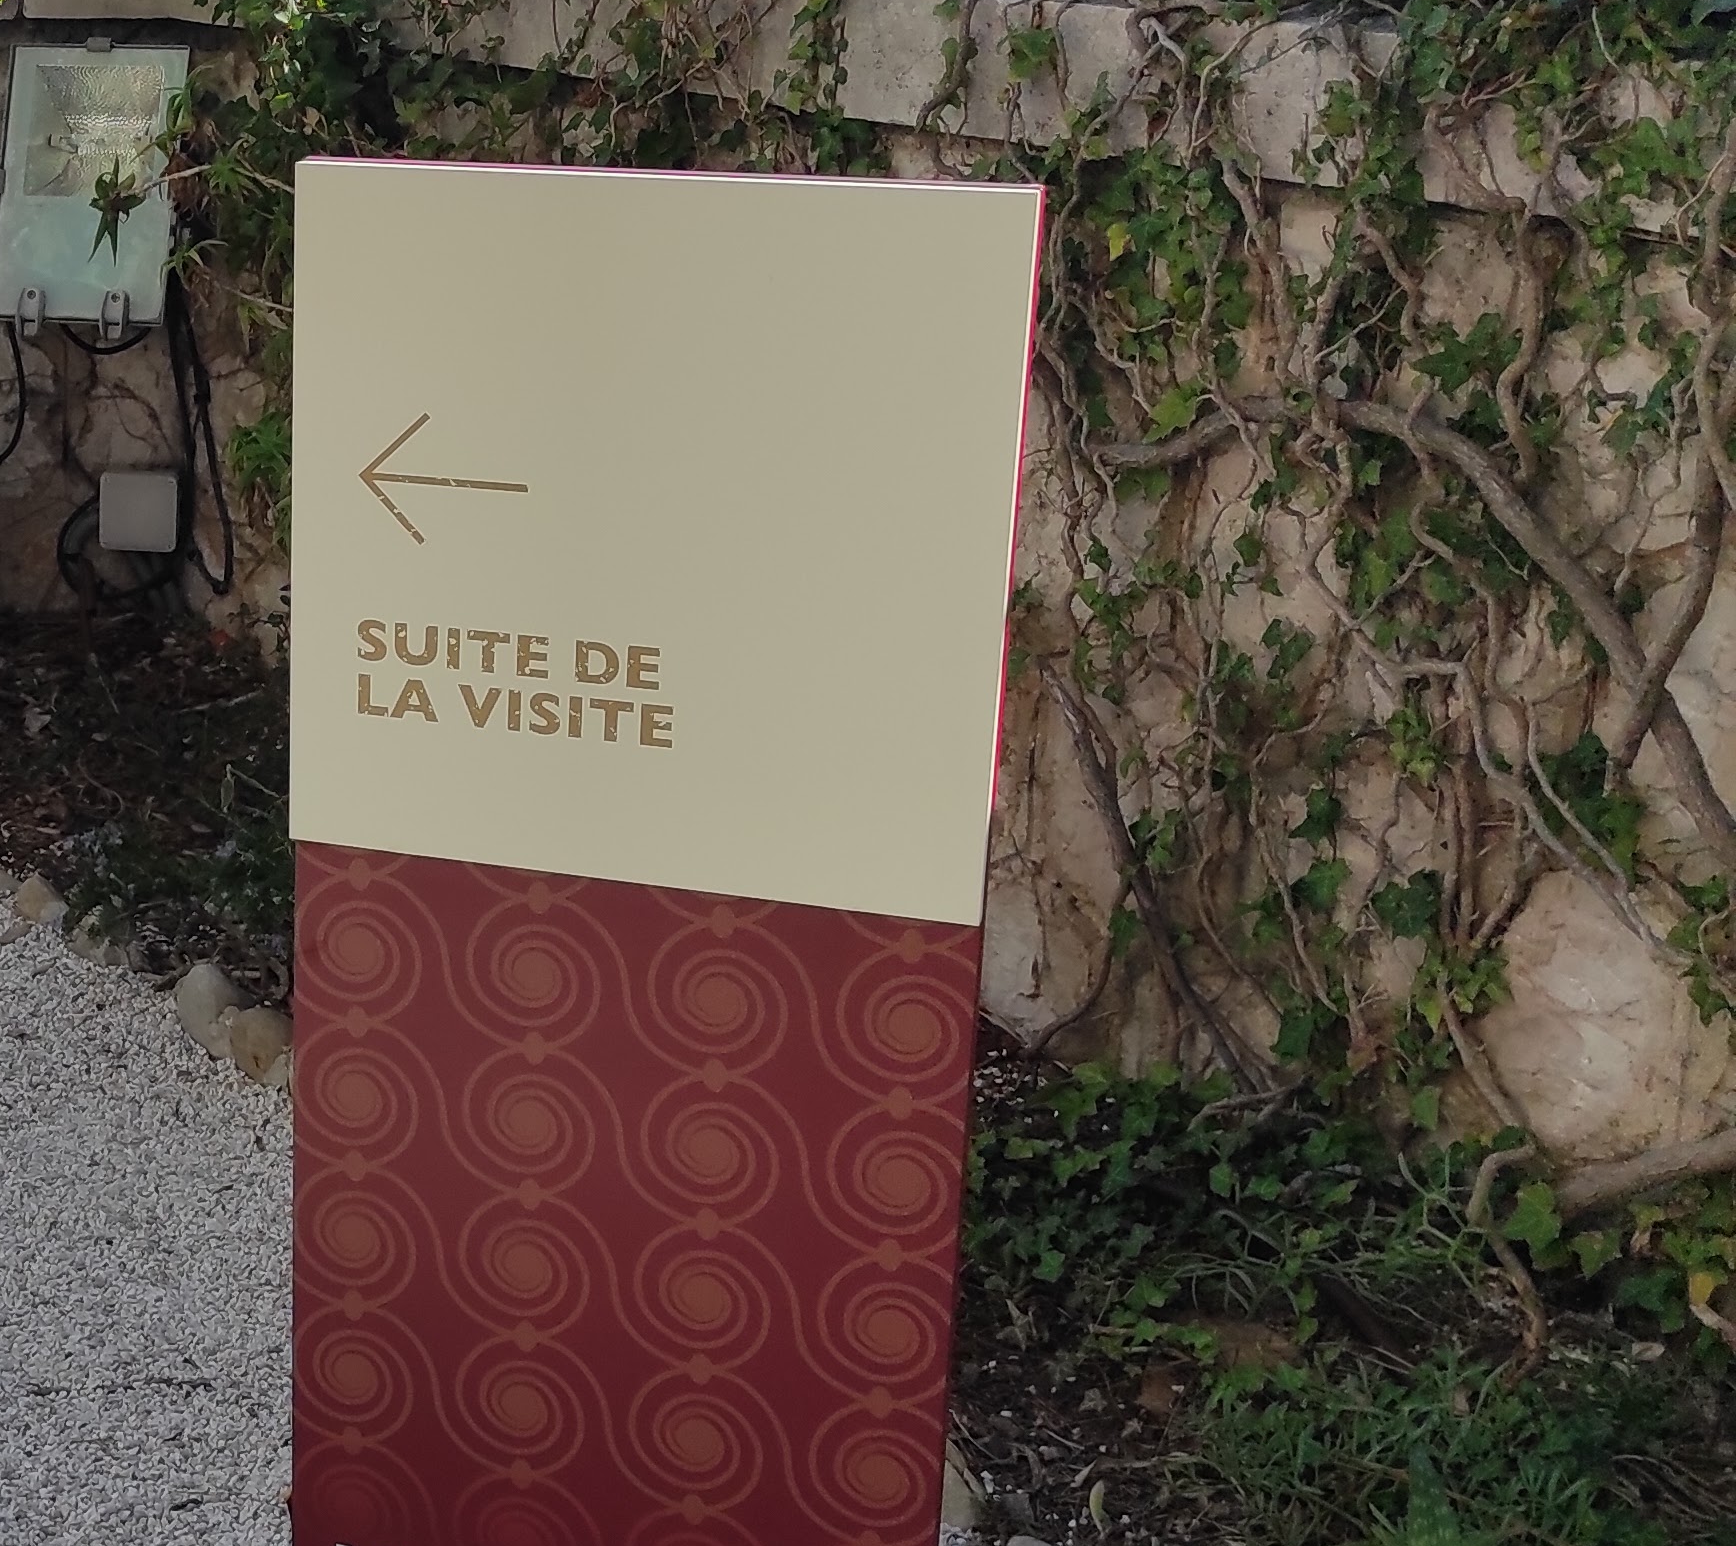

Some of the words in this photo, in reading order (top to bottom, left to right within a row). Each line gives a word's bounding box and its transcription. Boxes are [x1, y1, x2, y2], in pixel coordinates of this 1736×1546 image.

[356, 619, 550, 680] SUITE
[574, 639, 661, 691] DE
[357, 673, 439, 723] LA
[457, 683, 674, 749] VISITE
